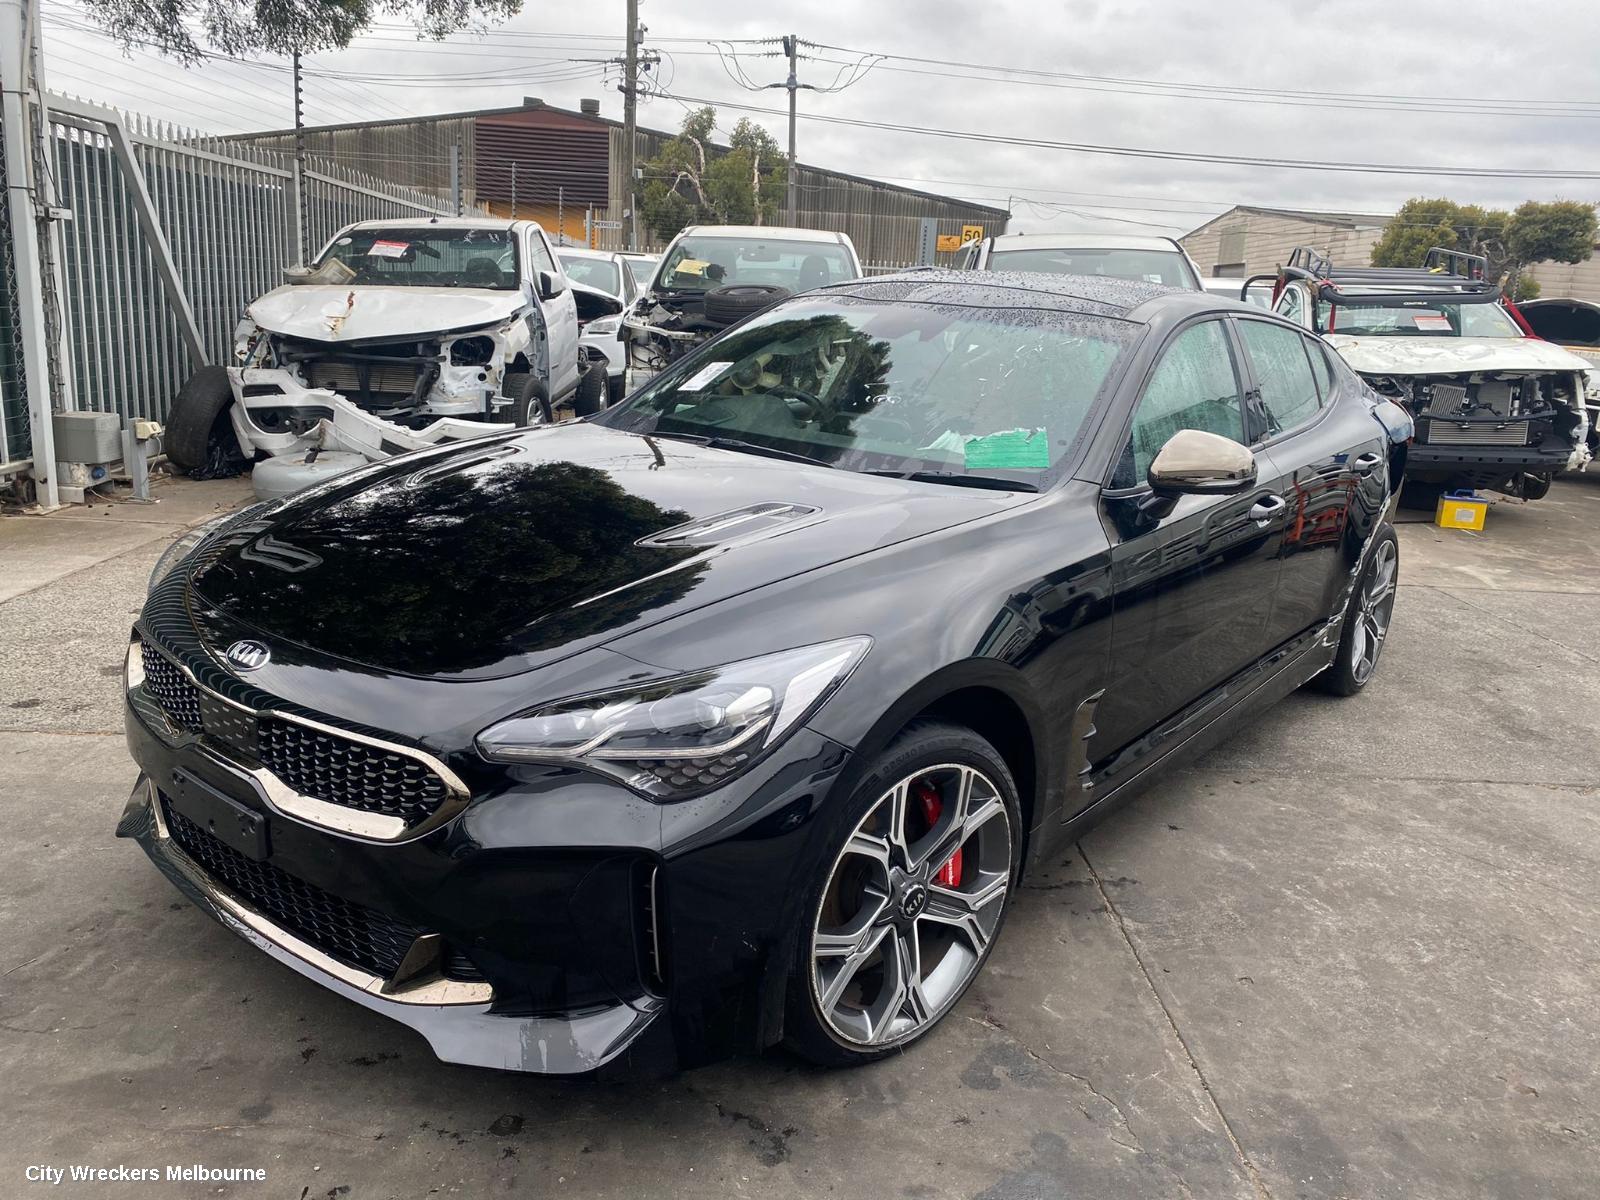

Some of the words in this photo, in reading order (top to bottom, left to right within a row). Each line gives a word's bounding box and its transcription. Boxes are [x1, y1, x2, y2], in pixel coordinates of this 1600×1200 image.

[964, 230, 981, 242] 50
[228, 641, 263, 667] KIA
[906, 893, 924, 915] KIA
